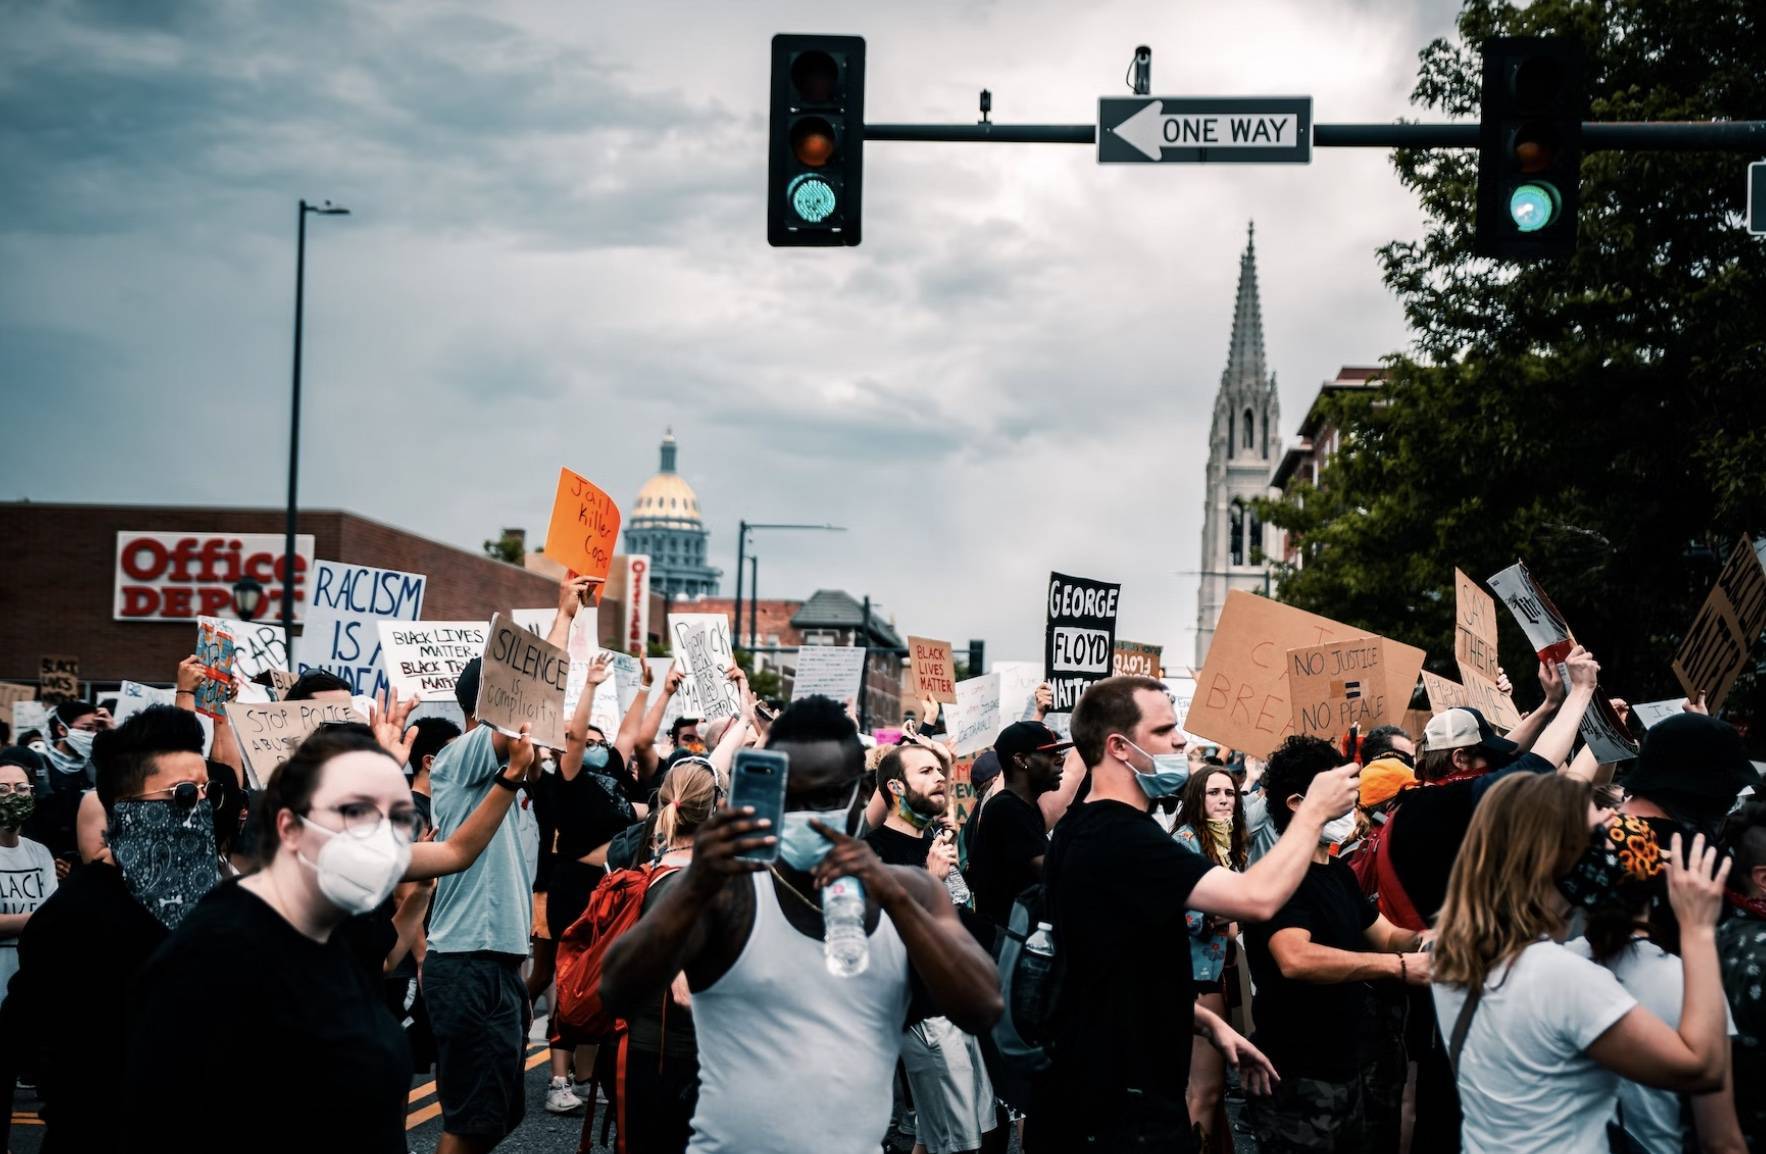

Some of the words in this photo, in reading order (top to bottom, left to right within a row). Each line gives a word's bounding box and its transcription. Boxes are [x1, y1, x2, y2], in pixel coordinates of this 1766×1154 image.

[1163, 118, 1218, 143] ONE
[1231, 118, 1288, 142] WAY
[570, 476, 611, 515] Jail
[578, 503, 611, 538] Killer
[121, 537, 306, 584] Office
[585, 535, 608, 568] Cops
[314, 566, 422, 621] RACISM
[1050, 580, 1118, 618] GEORGE
[331, 621, 361, 661] IS
[392, 630, 432, 645] BLACK
[434, 629, 484, 643] LIVES
[917, 645, 945, 660] BLACK
[1054, 632, 1108, 666] FLOYD
[1458, 625, 1498, 676] THEIR
[400, 660, 440, 674] BLACK
[493, 628, 569, 691] SILENCE
[919, 663, 944, 676] LIVES
[1294, 651, 1324, 676] NO
[1331, 647, 1378, 676] JUSTICE
[920, 677, 952, 693] MATTER
[246, 708, 288, 733] STOP
[300, 705, 357, 729] POLICE
[1302, 702, 1331, 732] NO
[1340, 695, 1384, 725] PEACE
